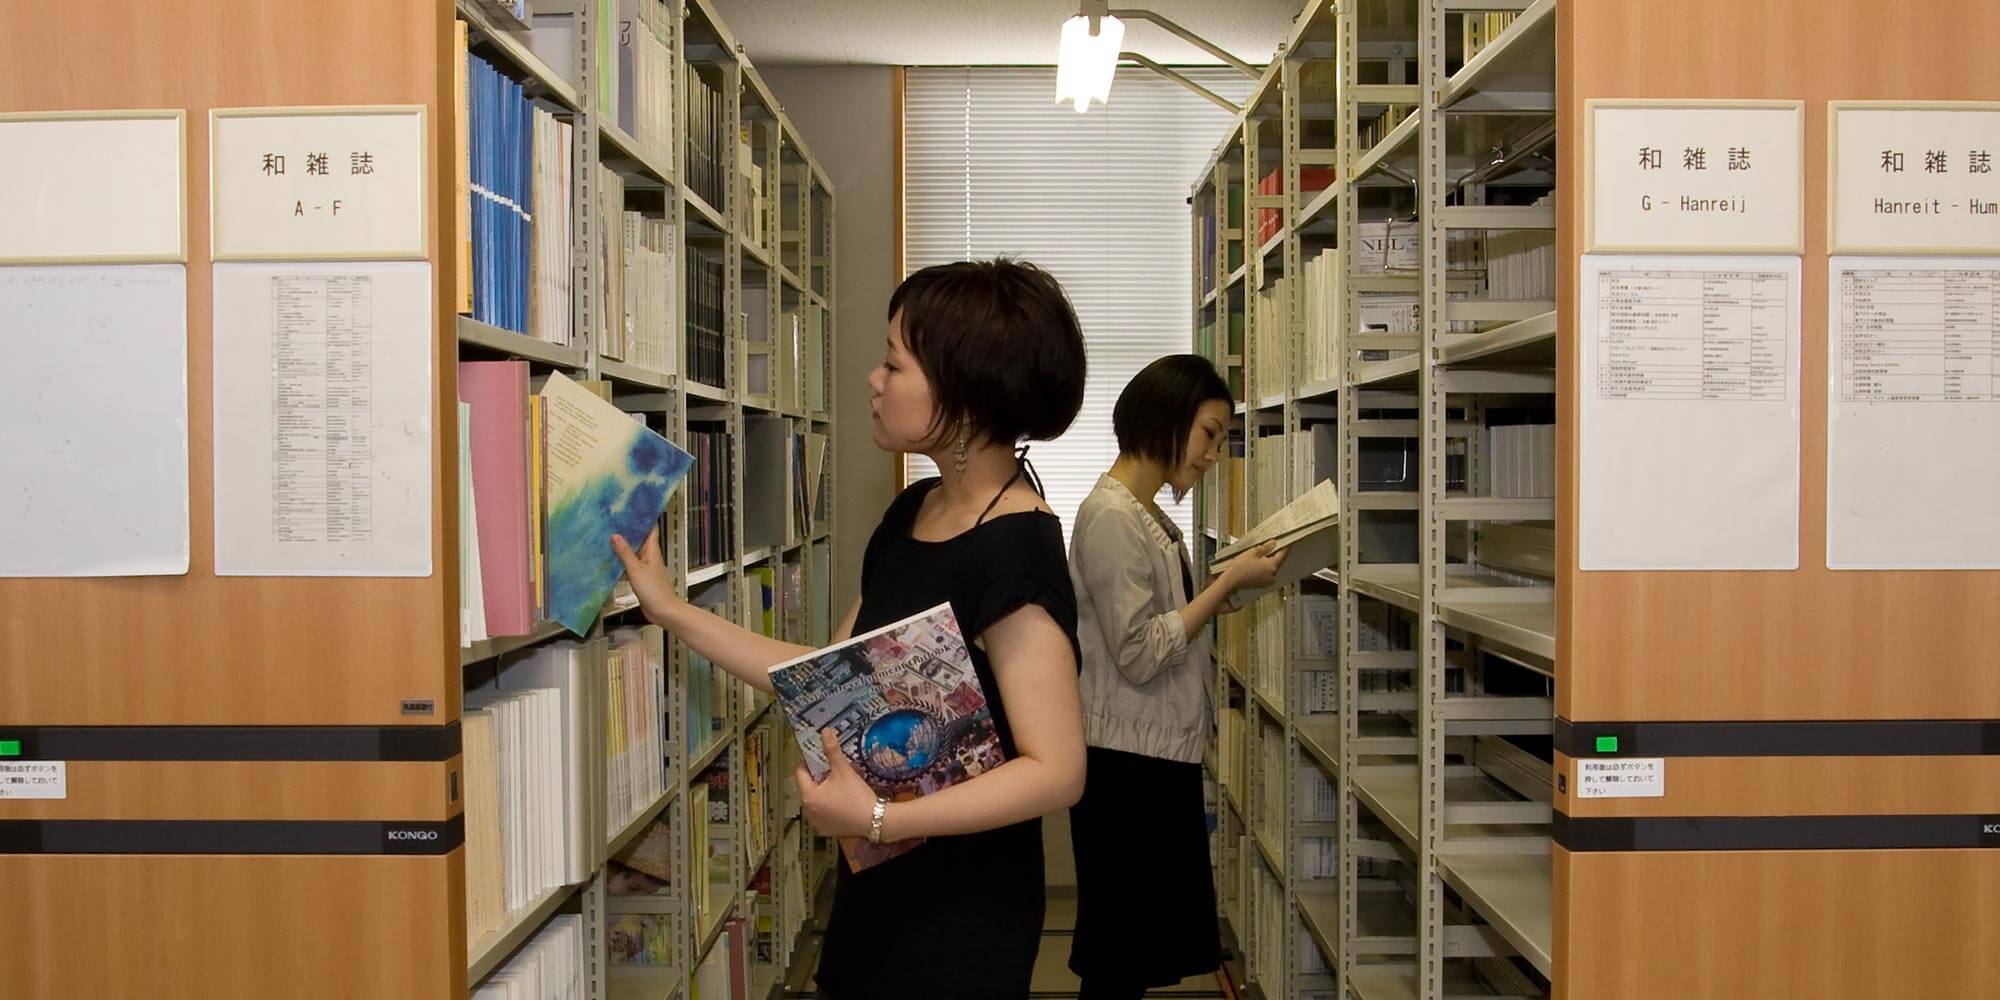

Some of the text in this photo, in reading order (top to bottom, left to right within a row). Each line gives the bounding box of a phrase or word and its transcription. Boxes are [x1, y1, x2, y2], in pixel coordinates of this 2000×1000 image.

[294, 200, 304, 217] A
[332, 200, 342, 217] F
[1641, 195, 1652, 211] G
[1680, 195, 1745, 214] Hanreij
[1874, 198, 1941, 215] Hanreit
[1969, 199, 1998, 215] Hum
[387, 830, 438, 841] KONGO
